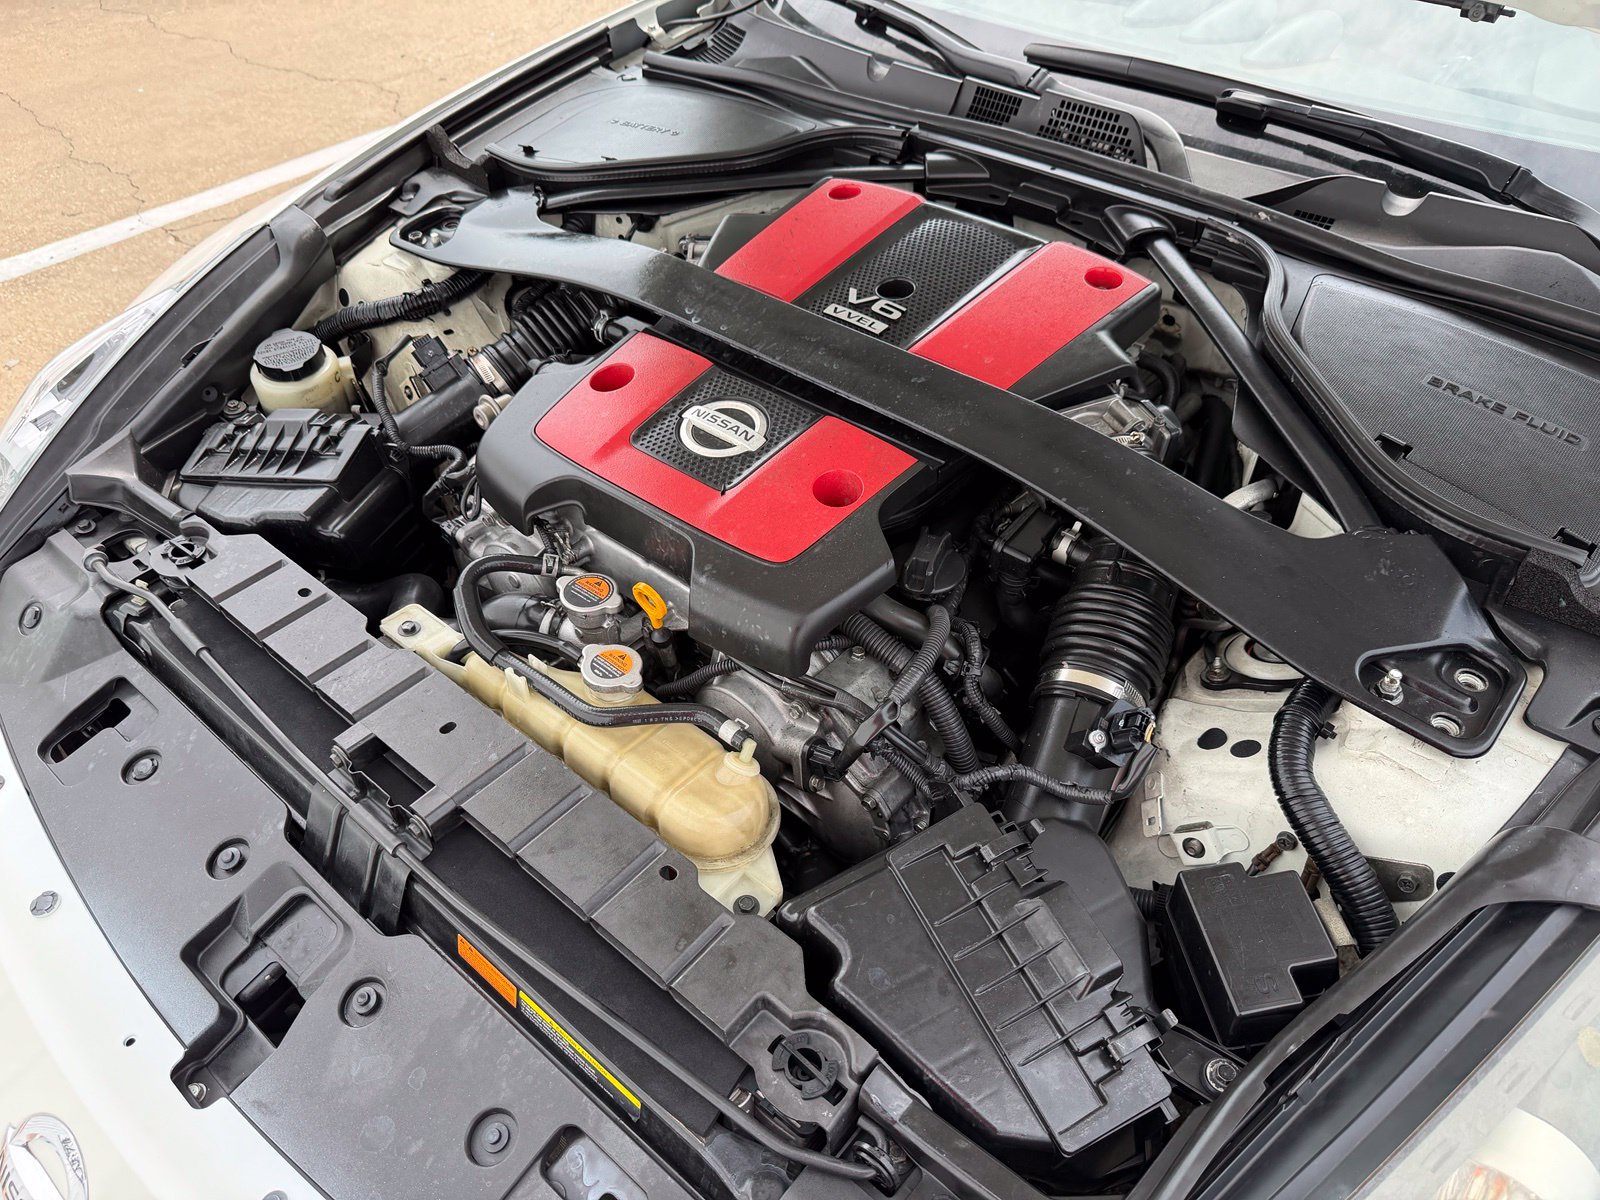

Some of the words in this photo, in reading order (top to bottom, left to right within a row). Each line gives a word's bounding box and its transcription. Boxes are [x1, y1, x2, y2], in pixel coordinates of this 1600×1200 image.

[832, 306, 878, 331] VVEL
[848, 287, 907, 320] V6
[691, 408, 755, 442] NISSAN
[1427, 375, 1508, 415] BRAKE
[1512, 410, 1582, 446] FLUID
